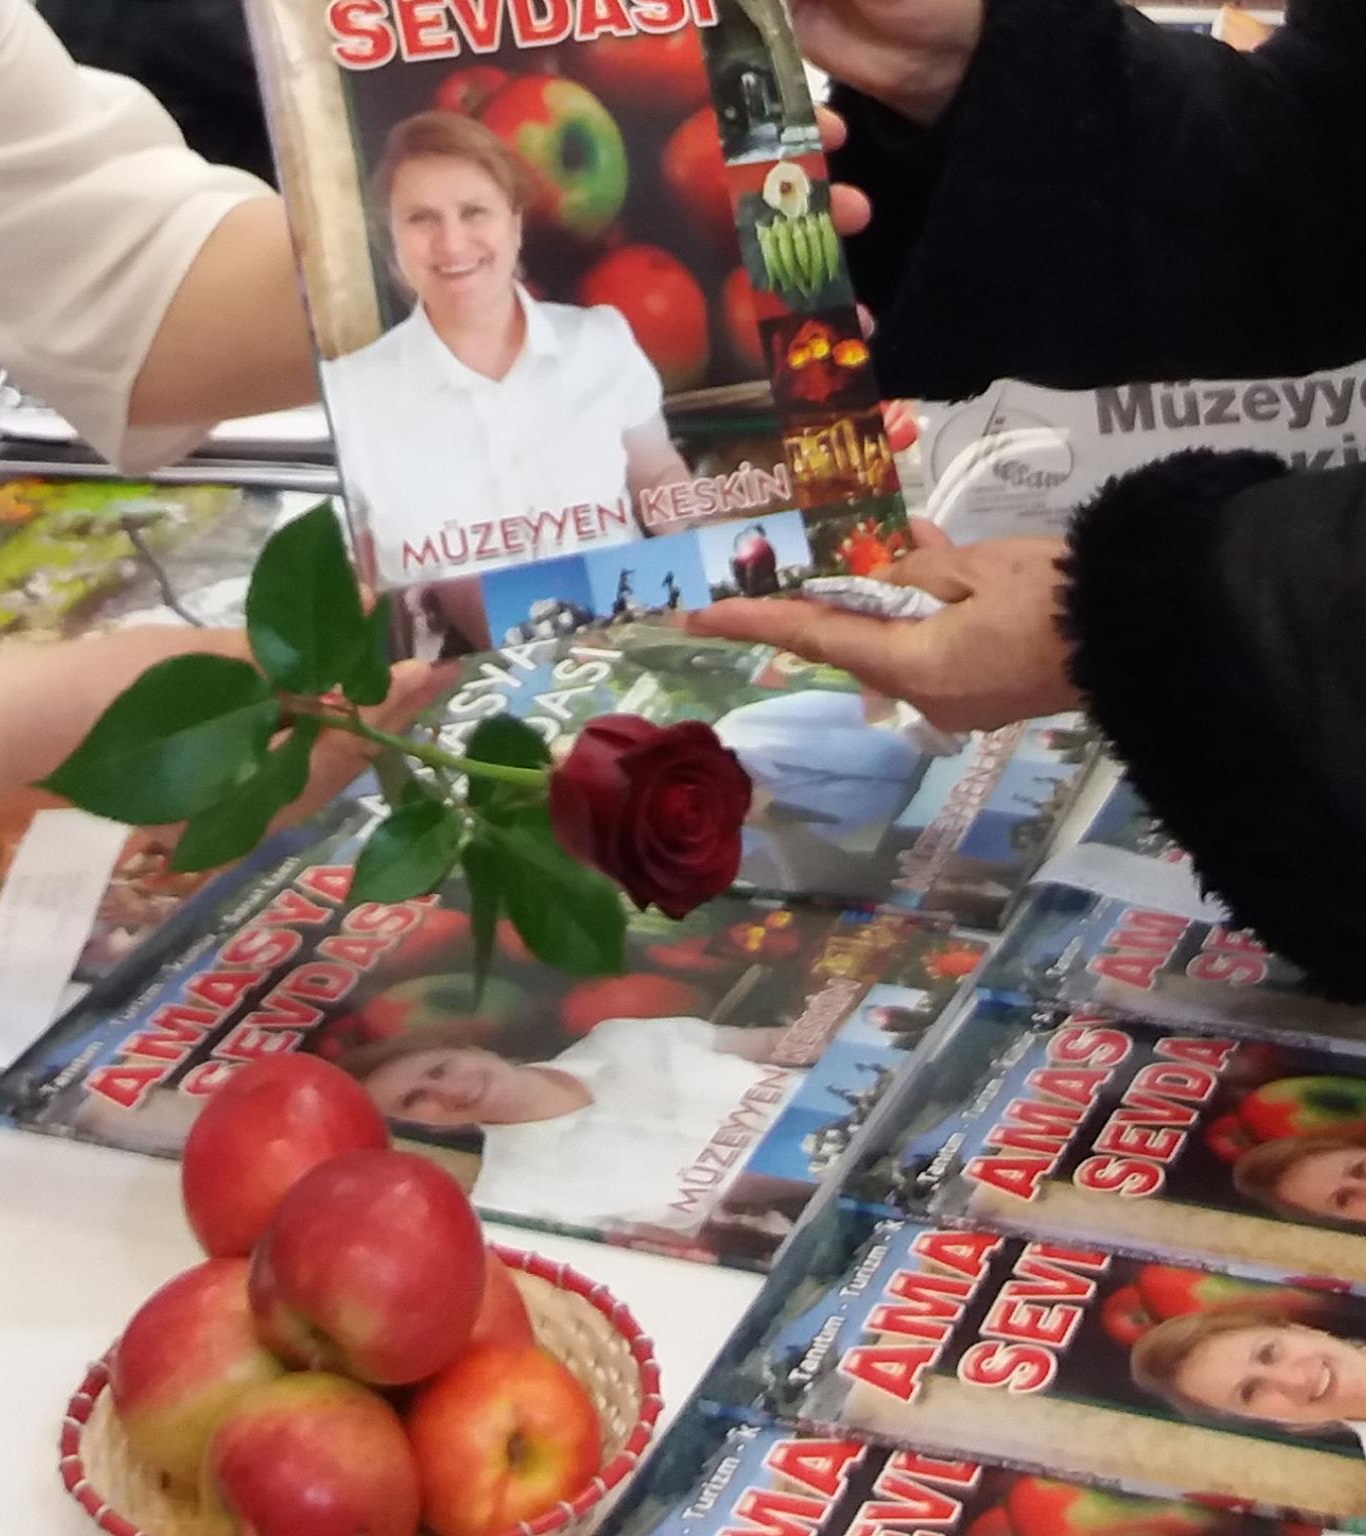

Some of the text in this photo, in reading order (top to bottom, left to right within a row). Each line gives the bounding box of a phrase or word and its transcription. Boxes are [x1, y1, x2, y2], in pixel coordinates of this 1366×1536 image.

[401, 460, 795, 570] MÜZEYYEN KESKİN
[83, 864, 356, 1111] AMASYA
[670, 1065, 792, 1214] MÜZEYYEN
[961, 1012, 1135, 1202] AMAS
[1072, 1036, 1241, 1199] SEVDA
[837, 1228, 1006, 1405] AMA
